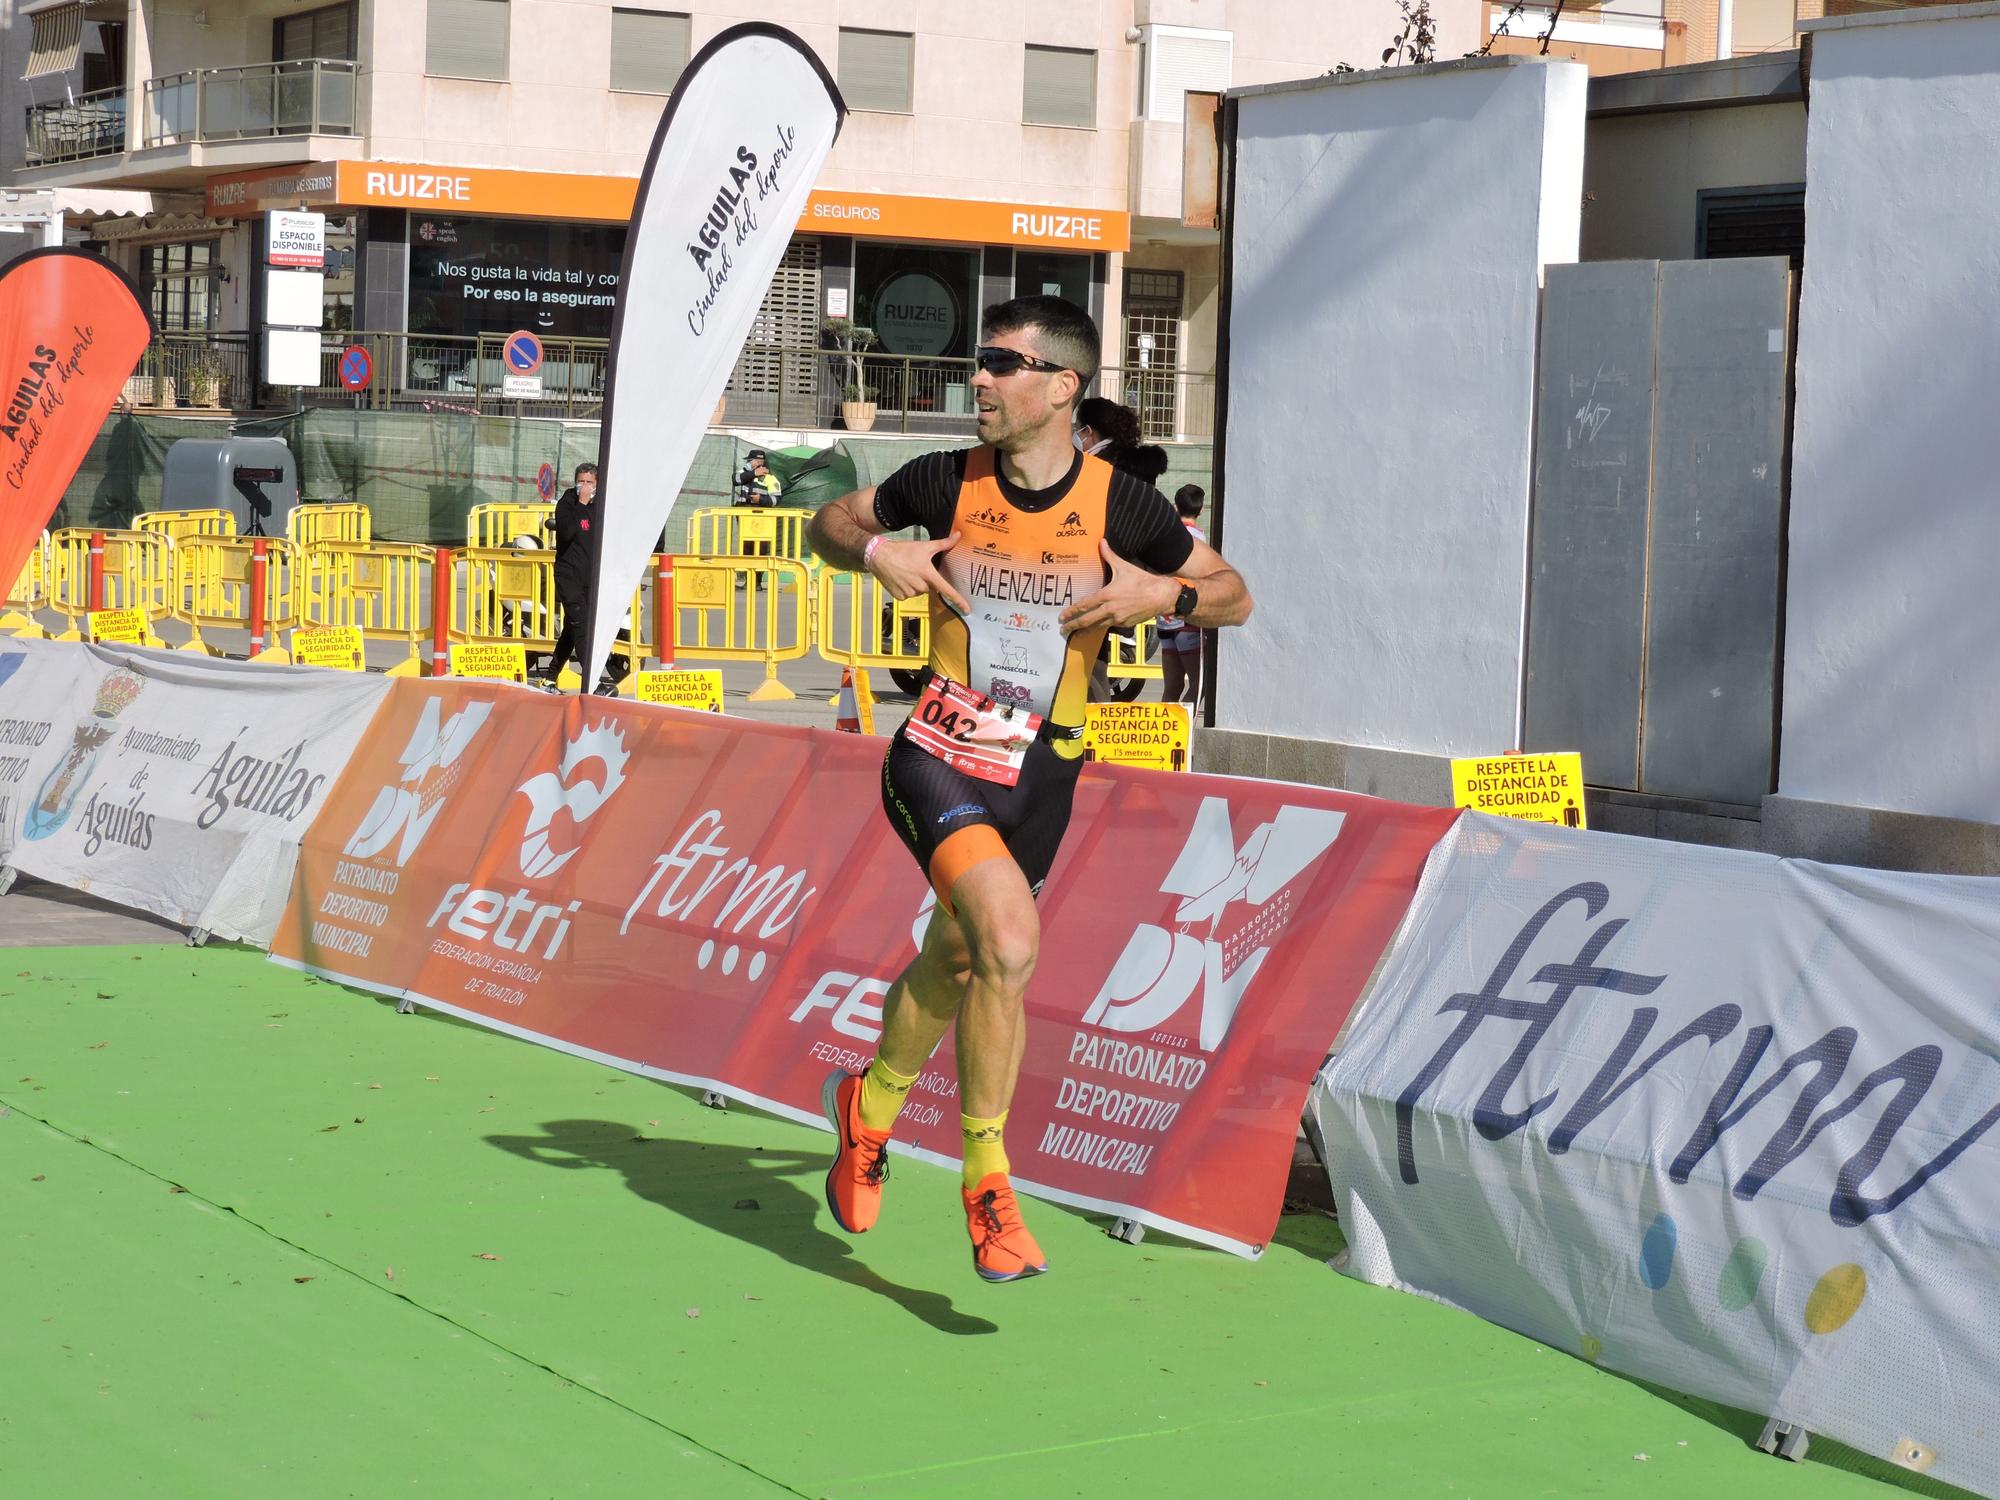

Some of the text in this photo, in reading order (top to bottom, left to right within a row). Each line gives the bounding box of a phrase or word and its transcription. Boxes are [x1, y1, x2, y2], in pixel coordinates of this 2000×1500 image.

[367, 172, 471, 200] RUIZRE
[687, 145, 757, 272] ÁGUILAS
[813, 204, 880, 221] SEGUROS
[280, 231, 315, 241] ESPACIO
[436, 235, 458, 243] english
[688, 124, 794, 336] Ciudad del deporte
[1012, 212, 1101, 240] RUIZRE
[272, 241, 322, 251] DISPONIBLE
[438, 262, 467, 277] Nos
[471, 265, 511, 281] gusta
[515, 266, 527, 280] la
[532, 268, 561, 282] vida
[566, 270, 582, 284] tal
[586, 274, 595, 288] y
[464, 284, 490, 299] Por
[494, 290, 520, 300] eso
[525, 288, 538, 302] la
[885, 304, 948, 322] RUIZRE
[6, 325, 94, 489] Ciudad del deporte
[970, 562, 1073, 606] VALENZUELA
[300, 637, 343, 645] DISTANCIA
[305, 629, 336, 637] RESPETE
[305, 644, 351, 652] SEGURIDAD
[652, 674, 690, 682] RESPETE
[990, 663, 1028, 673] MONSECOR
[645, 683, 713, 692] DISTANCIA DE
[651, 693, 707, 702] SEGURIDAD
[922, 700, 978, 743] 042
[1091, 720, 1178, 731] DISTANCIA DE
[1100, 707, 1169, 717] RESPETE LA
[118, 725, 202, 761] Ayuntamiento
[1098, 733, 1170, 744] SEGURIDAD
[129, 762, 149, 790] de
[190, 726, 326, 830] Águilas
[1477, 760, 1556, 775] RESPETE LA
[1467, 775, 1568, 792] DISTANCIA DE
[1478, 791, 1560, 807] SEGURIDAD
[75, 782, 156, 857] Águilas
[1511, 811, 1543, 819] metros
[332, 861, 399, 896] PATRONATO
[619, 809, 817, 939] ftrm
[320, 891, 390, 927] DEPORTIVO
[1224, 890, 1291, 949] PATRONATO
[311, 921, 375, 958] MUNICIPAL
[1224, 902, 1289, 963] DEPORTIVO
[1224, 916, 1289, 976] MUNICIPAL
[431, 939, 543, 984] FEDERACIÓN ESPAÑOLA
[464, 978, 527, 1007] DE TRIATLÓN
[1068, 1031, 1206, 1090] PATRONATO
[1396, 881, 2000, 1228] ftrm
[1055, 1077, 1181, 1133] DEPORTIVO
[1038, 1122, 1154, 1176] MUNICIPAL
